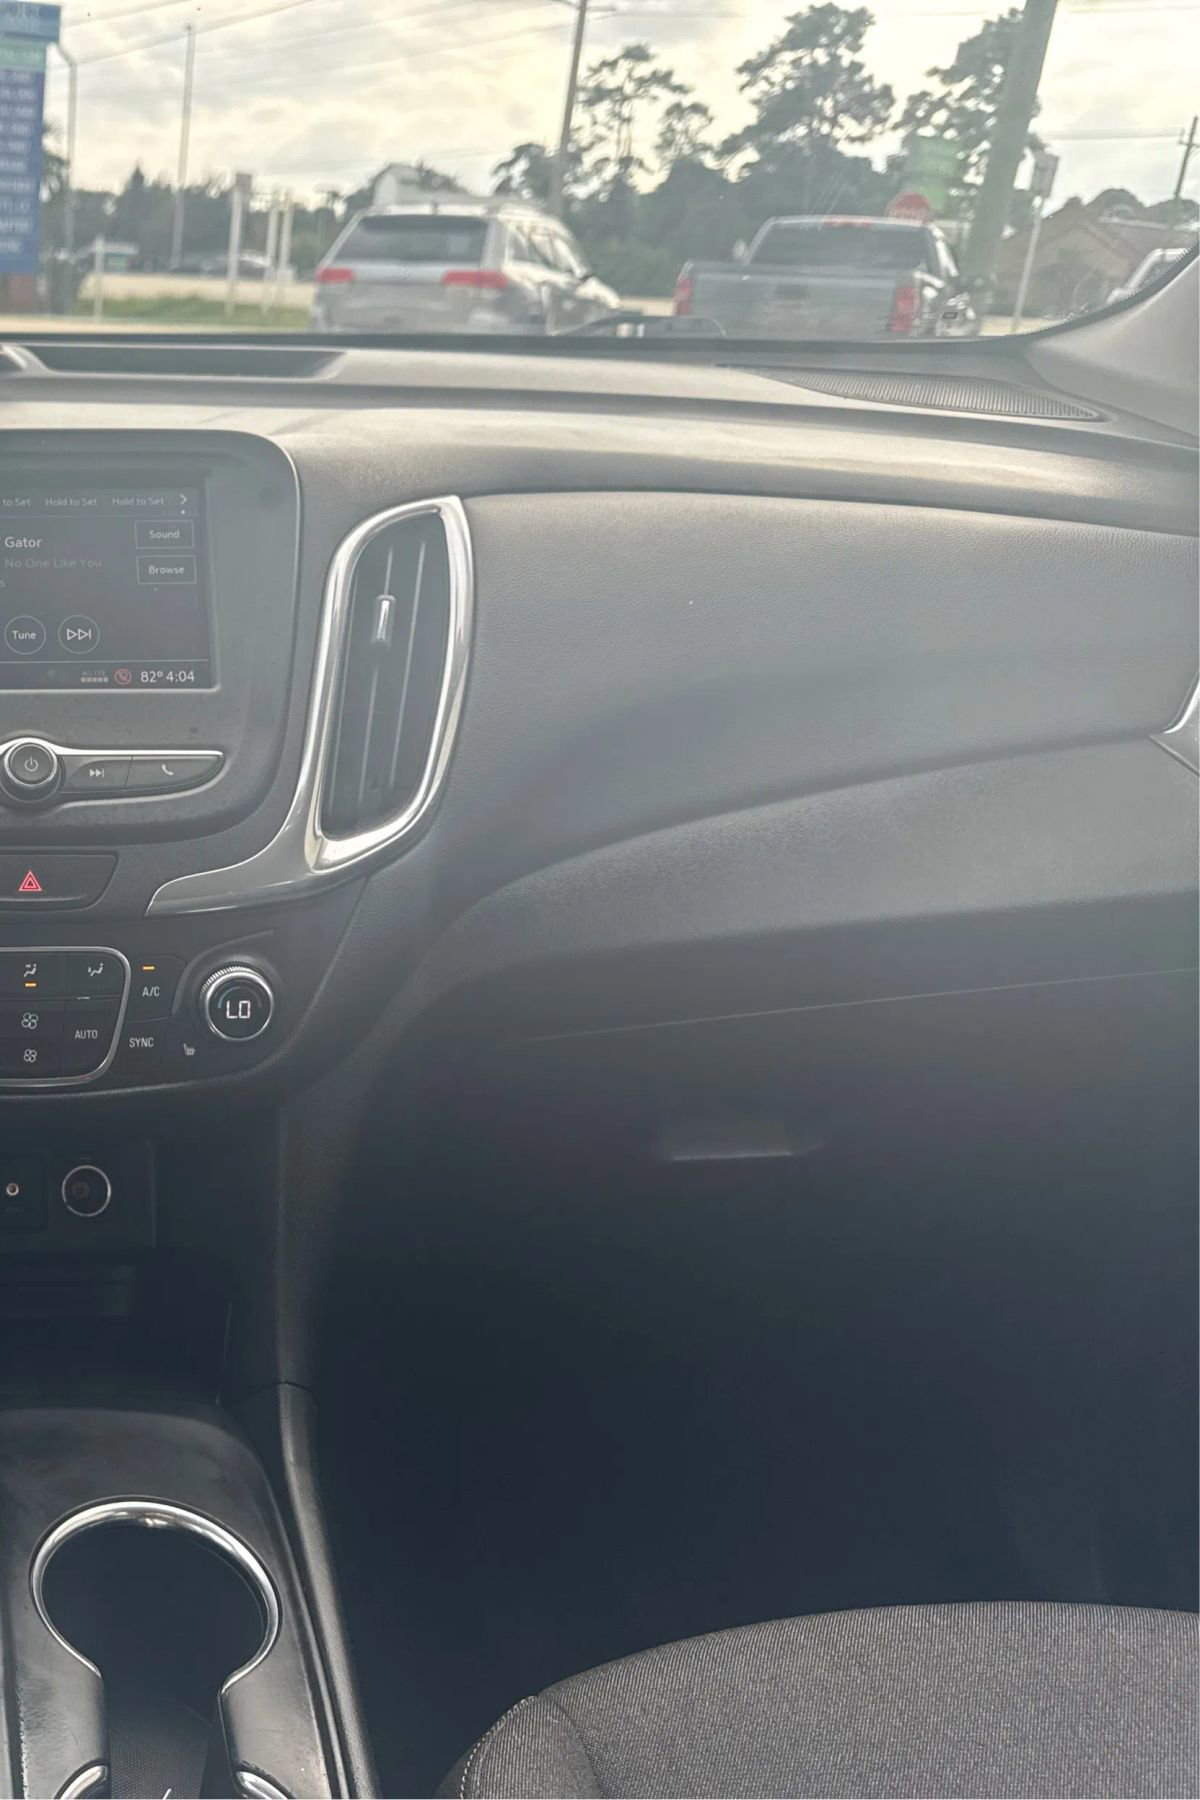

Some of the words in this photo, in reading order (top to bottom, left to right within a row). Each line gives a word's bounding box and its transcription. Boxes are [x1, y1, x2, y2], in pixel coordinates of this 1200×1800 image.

[2, 498, 12, 507] to
[14, 497, 32, 507] Set
[45, 497, 68, 507] Hold
[69, 497, 79, 507] to
[81, 497, 98, 507] Set
[112, 497, 135, 506] Hold
[136, 497, 146, 506] to
[148, 496, 165, 506] Set
[149, 530, 180, 539] Sound
[4, 536, 42, 549] Gator
[4, 558, 22, 569] No
[25, 558, 50, 569] One
[53, 558, 77, 569] Like
[79, 558, 102, 569] You
[148, 565, 185, 575] Browse
[11, 630, 37, 641] Tune
[166, 670, 195, 683] 4:04
[142, 985, 161, 998] A/C
[74, 1029, 99, 1041] AUTO
[128, 1036, 155, 1049] SYNC
